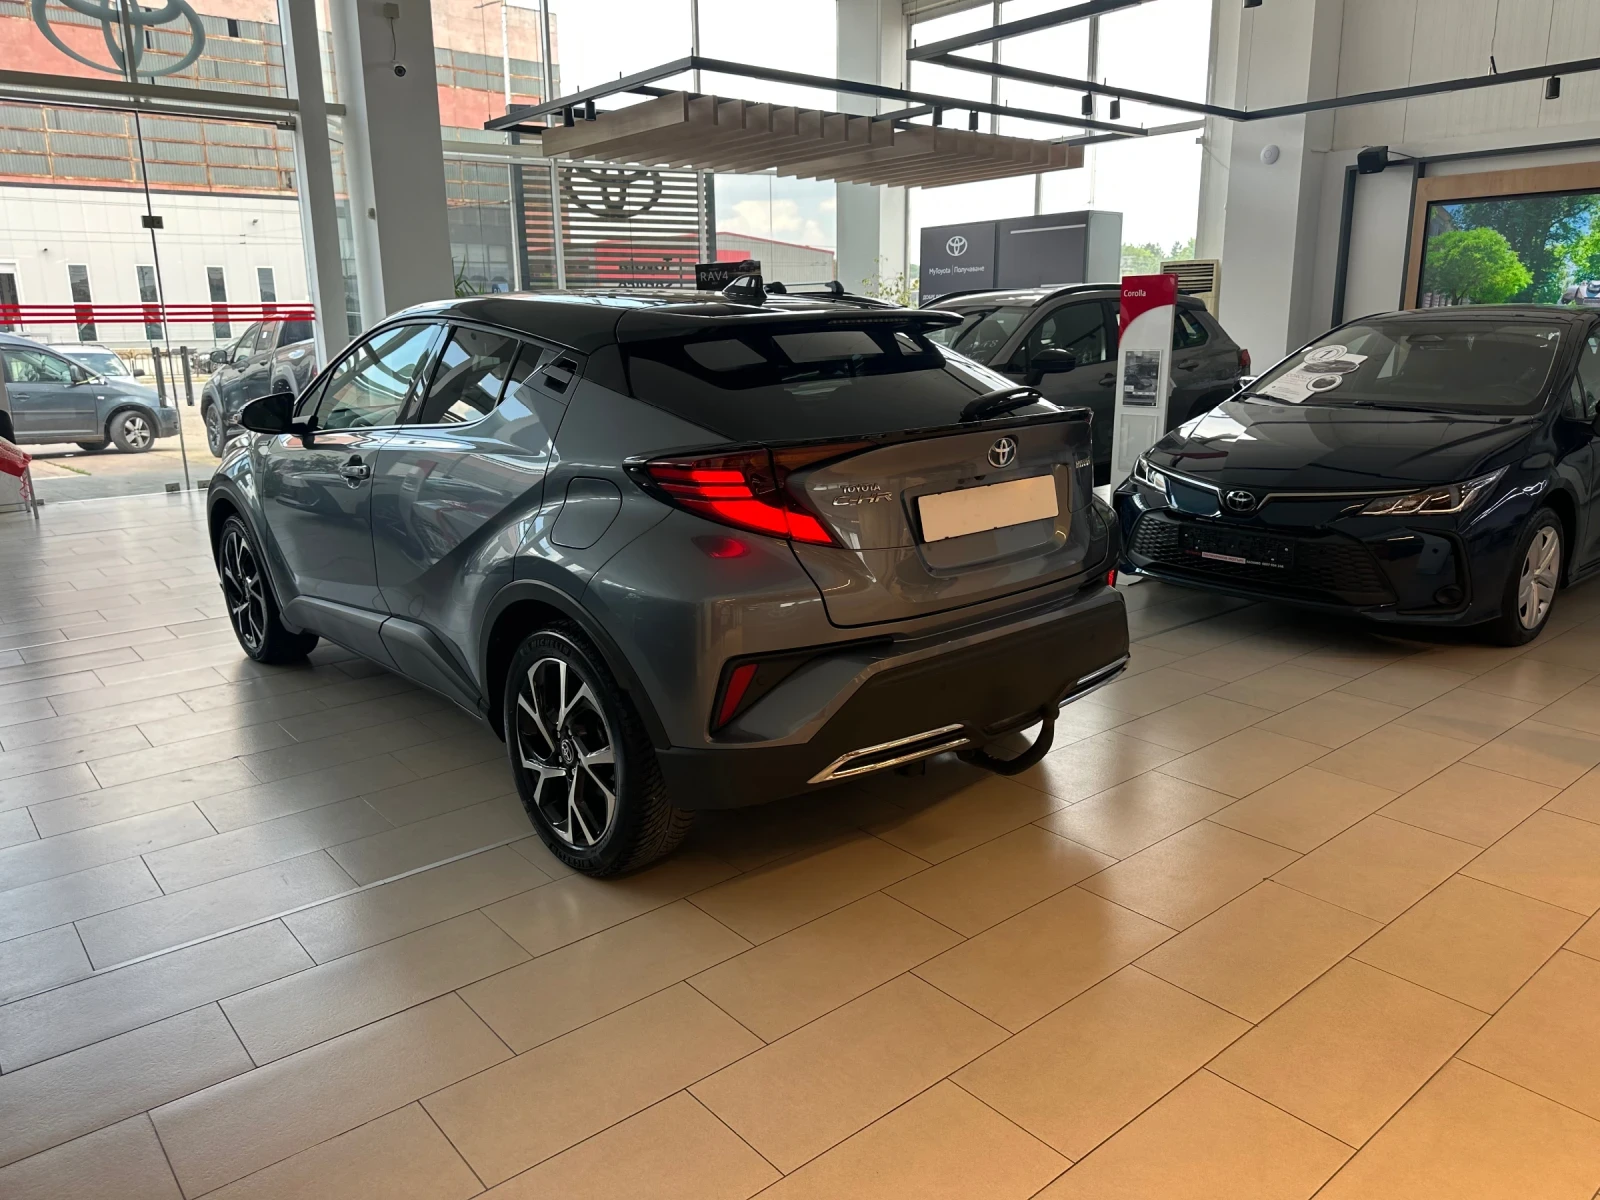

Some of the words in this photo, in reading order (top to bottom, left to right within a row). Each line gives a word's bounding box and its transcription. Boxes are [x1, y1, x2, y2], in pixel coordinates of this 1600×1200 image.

[700, 270, 729, 281] RAV4
[929, 267, 951, 276] MyToyota
[1123, 289, 1147, 297] Corolla
[841, 483, 881, 494] TOYOTA
[832, 492, 893, 506] C-HR
[530, 638, 571, 657] MICHELIN
